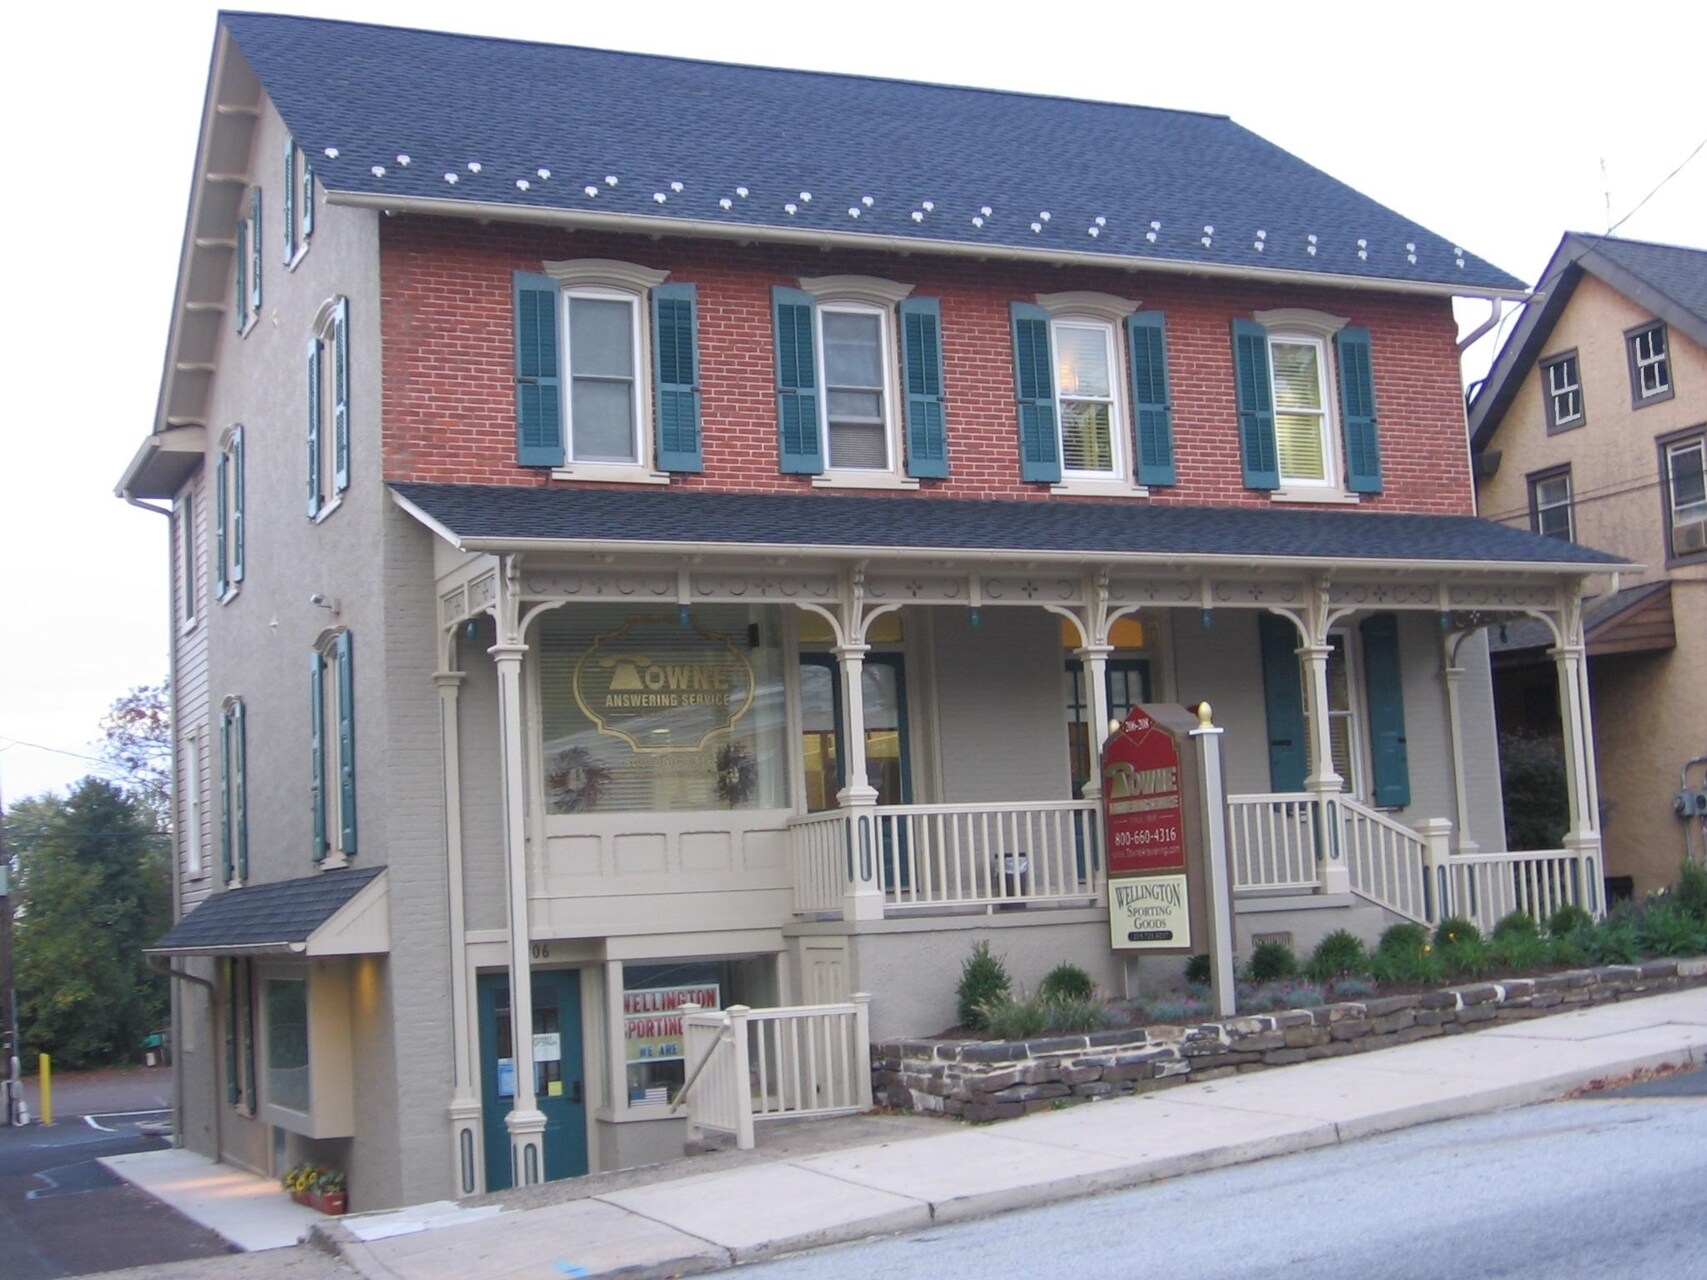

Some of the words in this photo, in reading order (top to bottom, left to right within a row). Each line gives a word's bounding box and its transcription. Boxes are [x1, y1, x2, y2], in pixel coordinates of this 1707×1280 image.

[606, 694, 678, 707] ANSWERING
[682, 693, 730, 706] SERVICE
[1115, 827, 1177, 846] 800-660-4316
[1115, 883, 1181, 909] WELLINGTON
[1127, 905, 1172, 918] SPORTING
[1134, 918, 1167, 930] GOODS
[640, 1045, 653, 1057] WE
[660, 1043, 678, 1056] ARE
